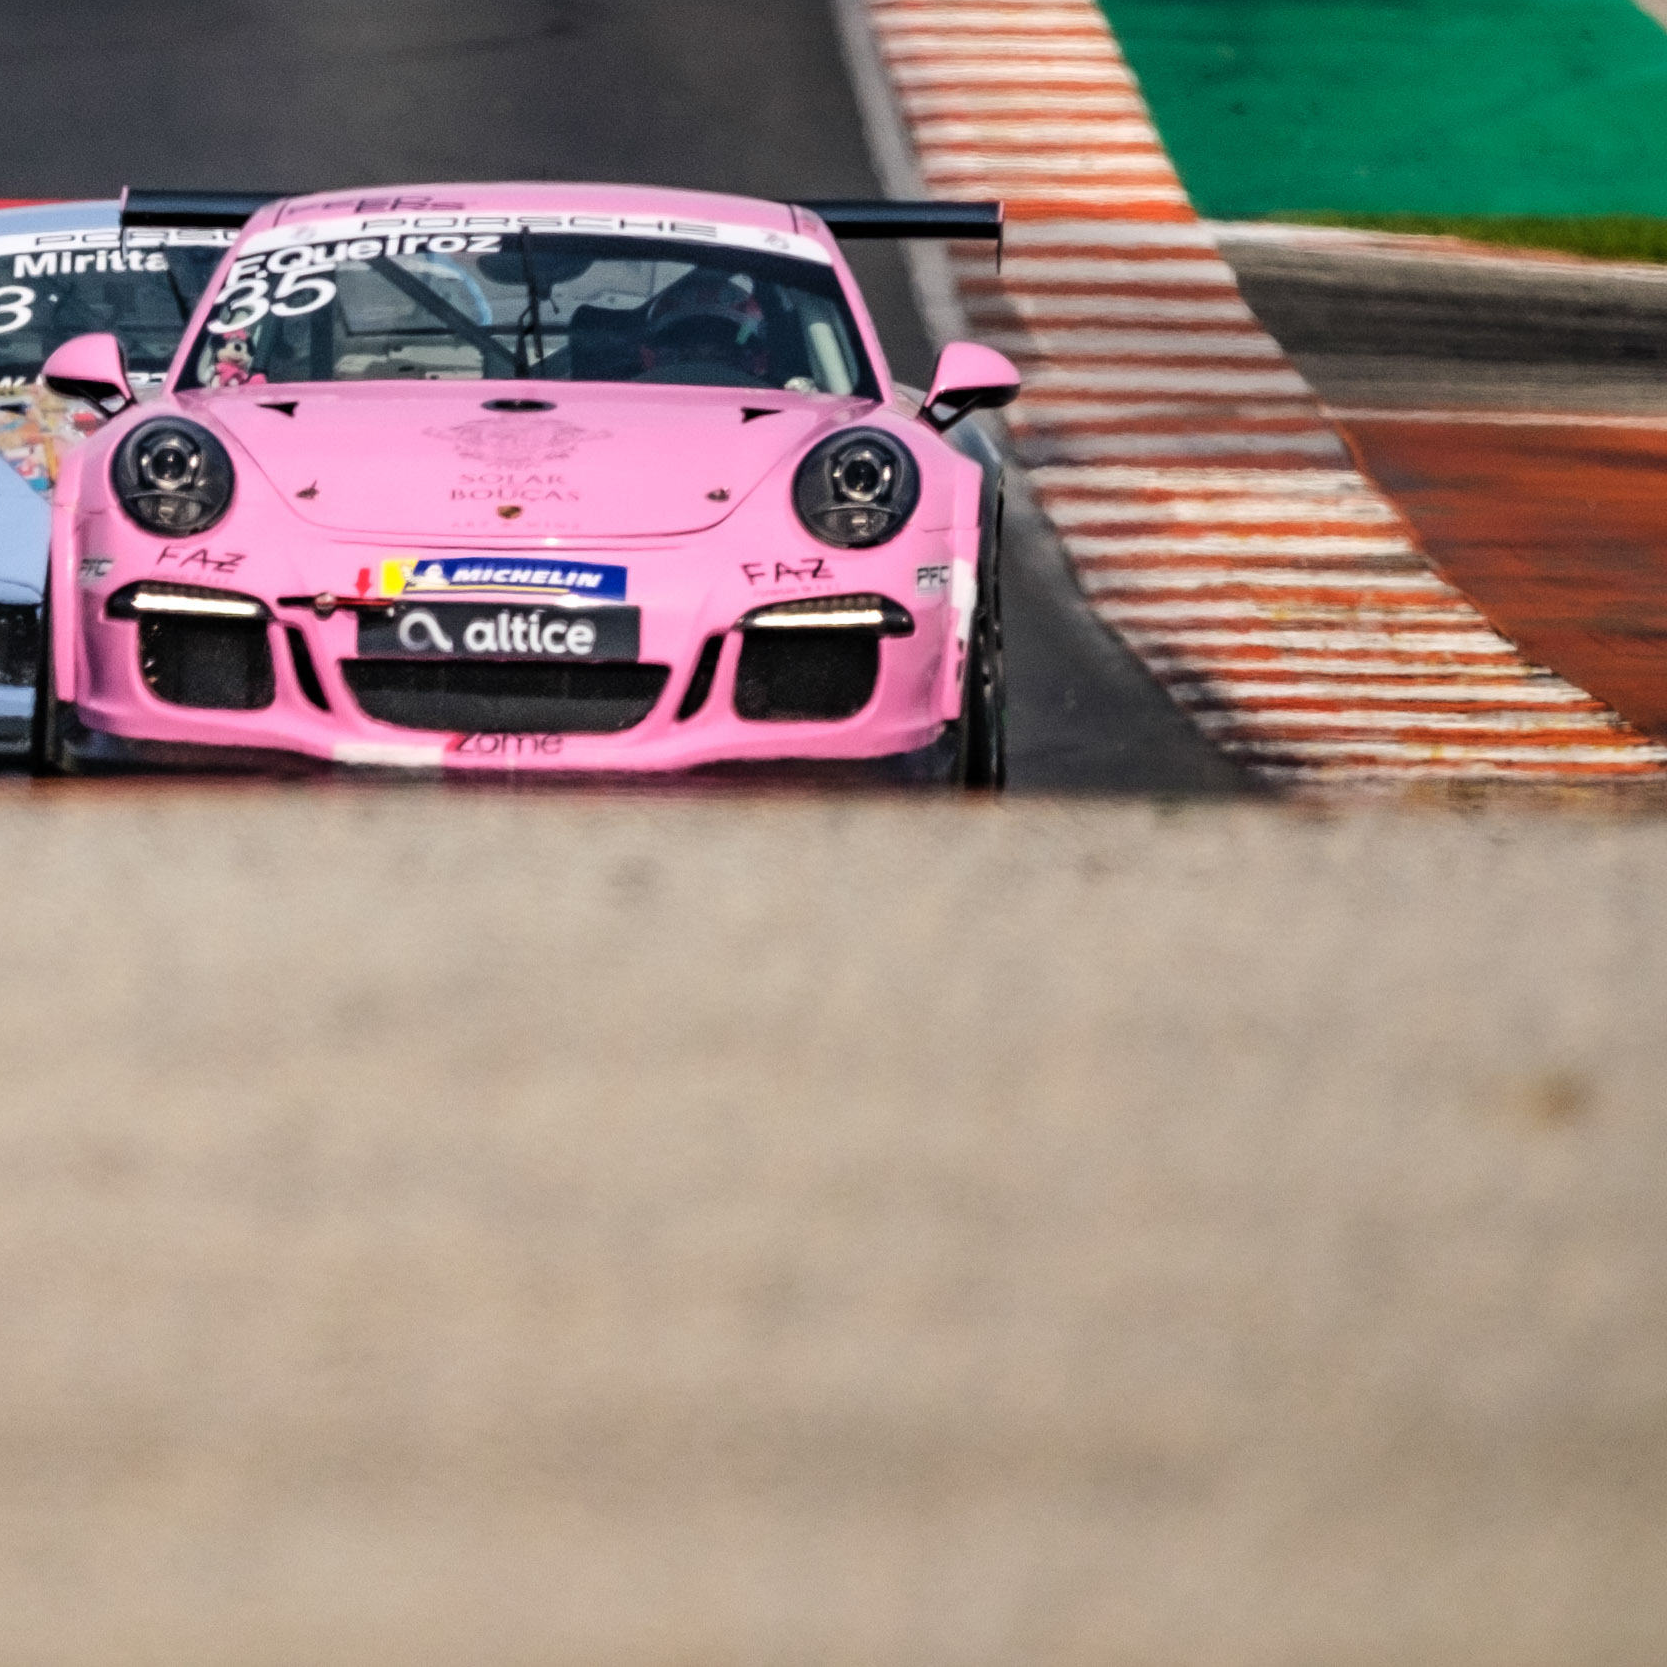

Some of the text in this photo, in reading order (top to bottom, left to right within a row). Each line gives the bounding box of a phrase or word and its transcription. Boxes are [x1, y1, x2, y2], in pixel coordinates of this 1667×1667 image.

[361, 216, 717, 237] PORSCHE
[208, 263, 337, 334] 35
[459, 474, 565, 485] SOLAR
[156, 546, 247, 574] FAZ
[741, 559, 835, 585] FAZ
[451, 568, 604, 588] MICHELIN
[463, 610, 596, 655] altice
